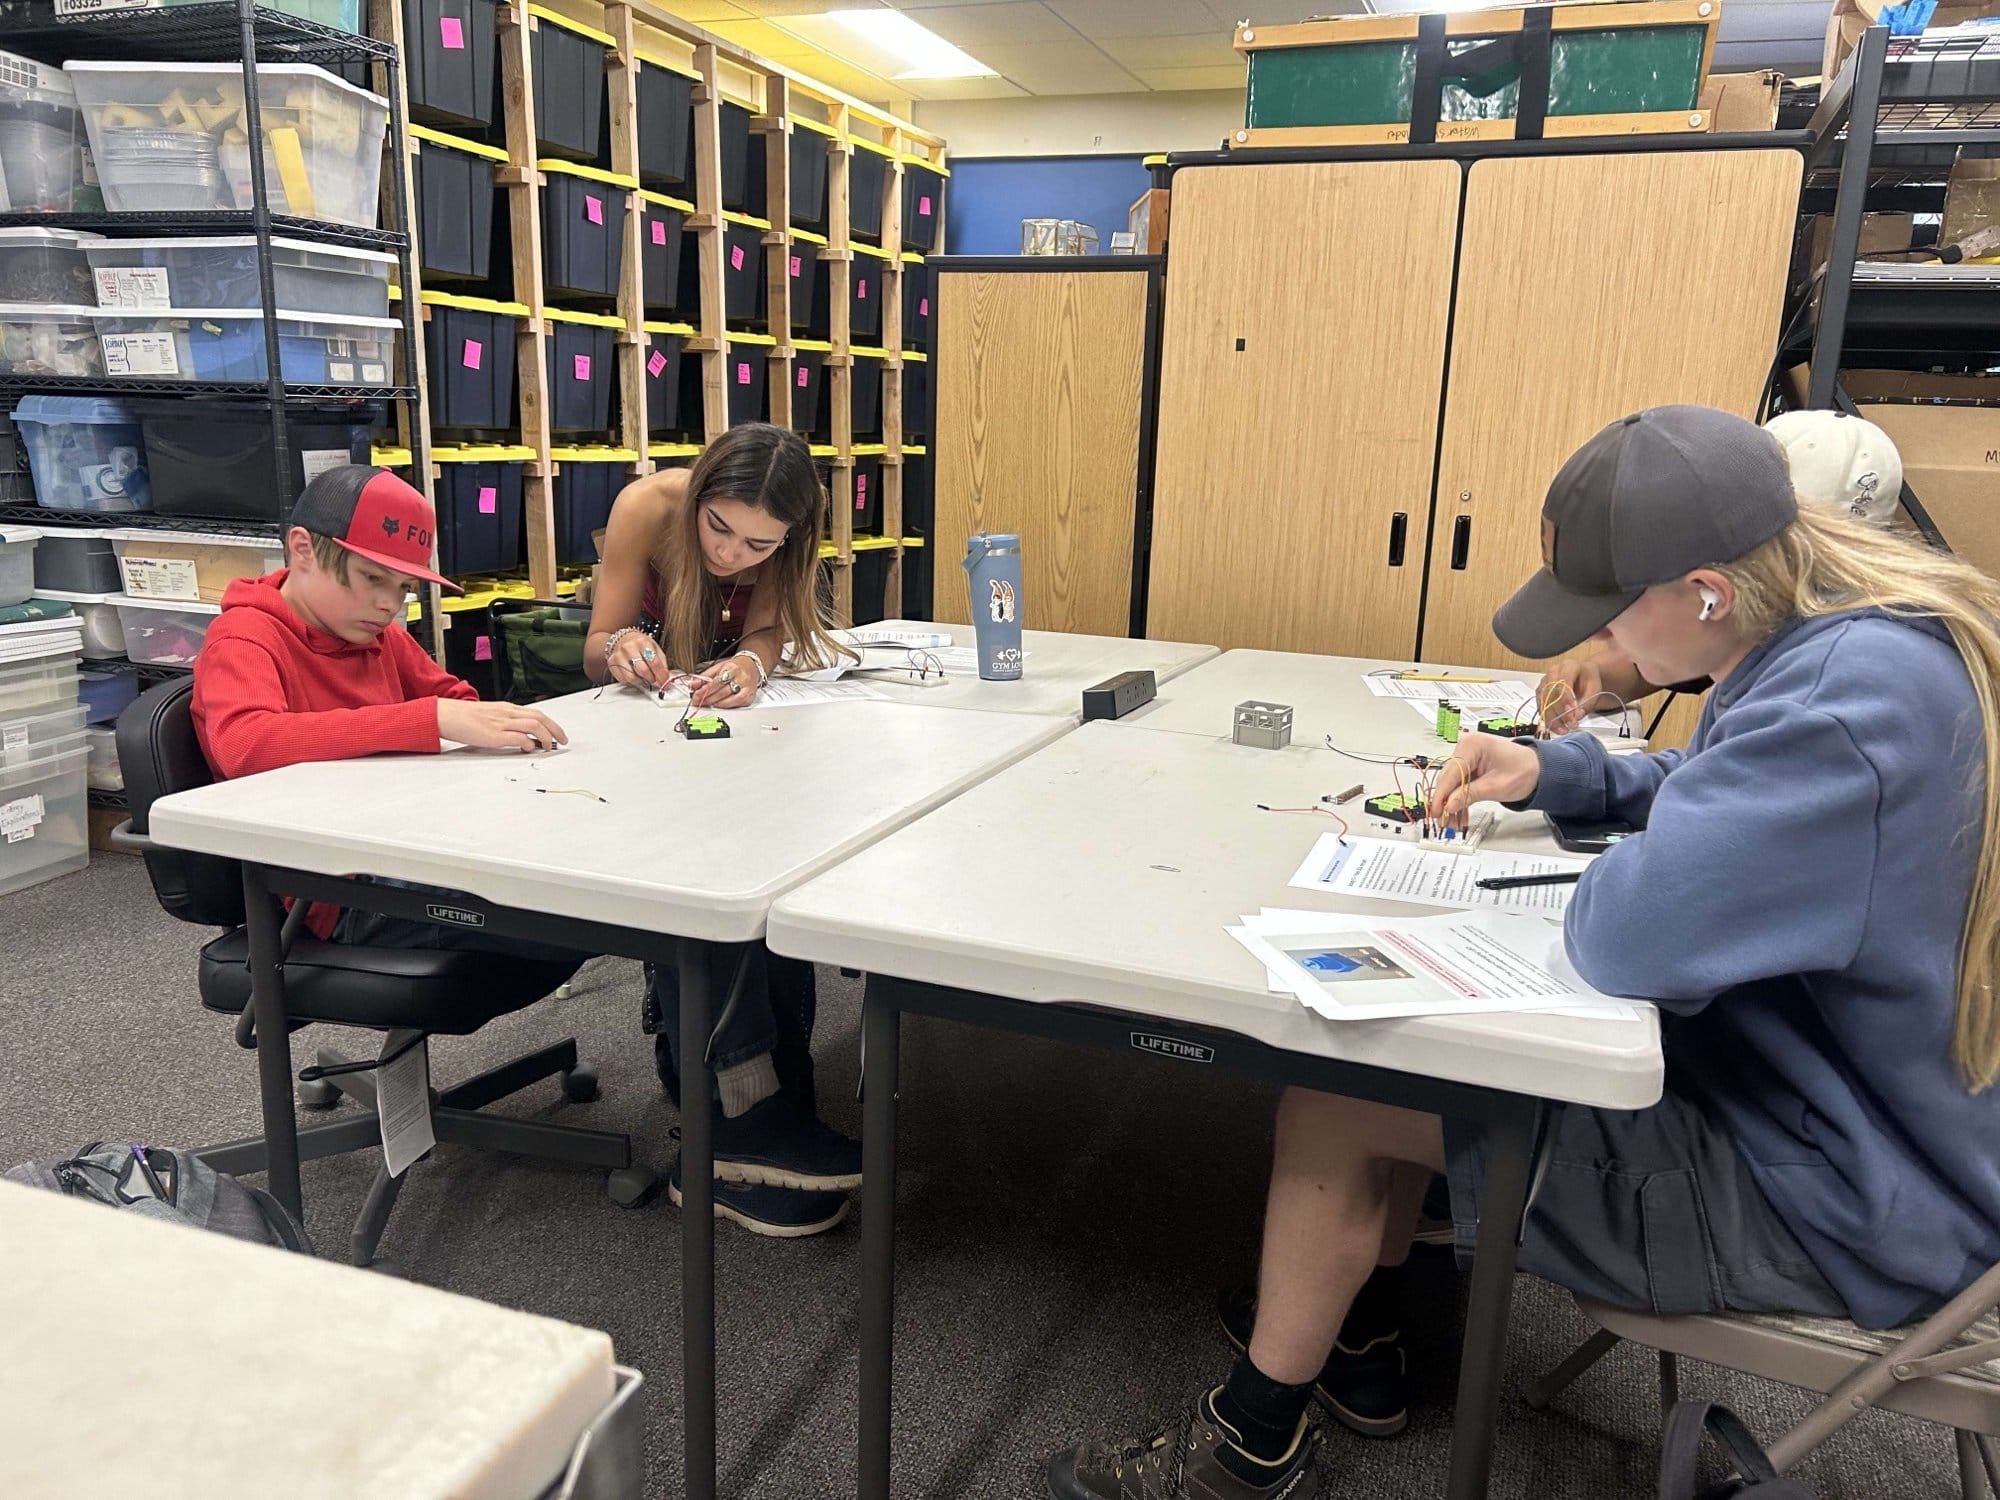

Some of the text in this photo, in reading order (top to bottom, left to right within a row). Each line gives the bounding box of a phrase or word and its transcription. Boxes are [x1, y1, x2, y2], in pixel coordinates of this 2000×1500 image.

[433, 907, 478, 923] LIFETIME
[1140, 1036, 1204, 1058] LIFETIME
[1272, 1470, 1305, 1500] CARPA
